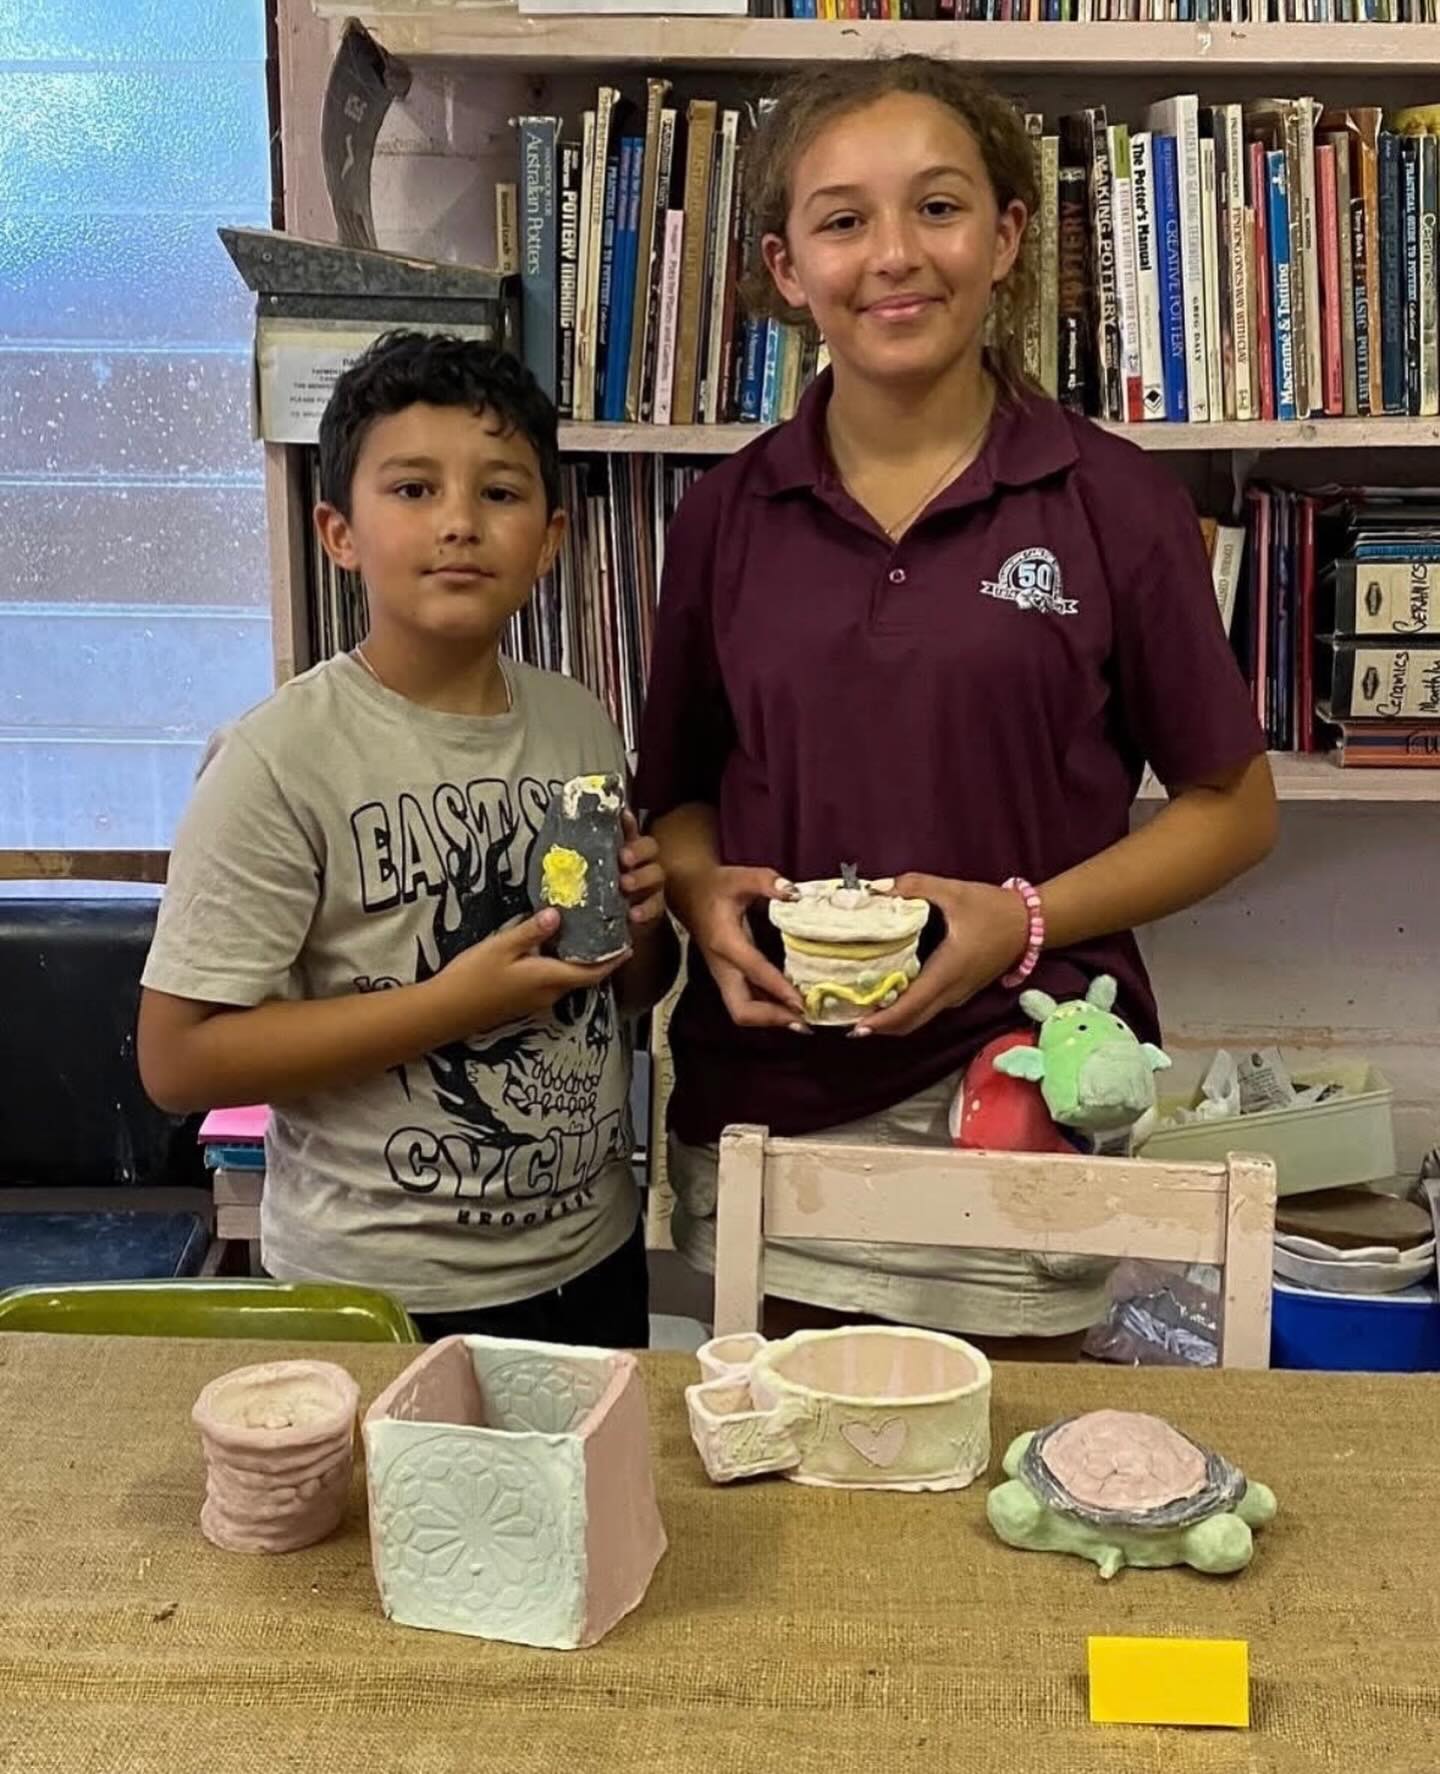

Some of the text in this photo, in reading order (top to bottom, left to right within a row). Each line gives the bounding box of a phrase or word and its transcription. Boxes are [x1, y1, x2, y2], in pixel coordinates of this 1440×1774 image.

[527, 131, 544, 275] Australian Potters
[606, 165, 617, 217] PRACTICAL
[1132, 141, 1152, 271] The Potter's Manual
[1406, 161, 1415, 213] PRACTICAL
[561, 190, 578, 260] POTTERY
[1097, 155, 1116, 328] MAKING POTTERY
[1231, 207, 1242, 253] FINDING
[1354, 209, 1363, 232] Tony
[603, 249, 612, 262] TO
[1062, 200, 1085, 313] POTTERY
[1166, 218, 1180, 292] CREATIVE
[1408, 245, 1417, 258] TO
[1422, 212, 1436, 287] Ceramics
[560, 263, 576, 329] MAKING
[600, 264, 611, 306] POTTERY
[1236, 288, 1245, 309] WAY
[1355, 285, 1367, 330] BASIC
[1408, 260, 1417, 302] POTTERY
[1170, 295, 1183, 360] POTTERY
[1194, 332, 1202, 363] DALY
[1236, 311, 1246, 339] WITH
[1277, 263, 1294, 404] Macramé & Tatting
[1238, 340, 1247, 364] CLAY
[1356, 335, 1369, 401] POTTERY
[1018, 563, 1053, 592] 50
[1392, 561, 1431, 635] CERAMICS
[1376, 651, 1410, 718] Ceramics
[1418, 660, 1440, 713] Monthly
[351, 777, 565, 914] EASTS
